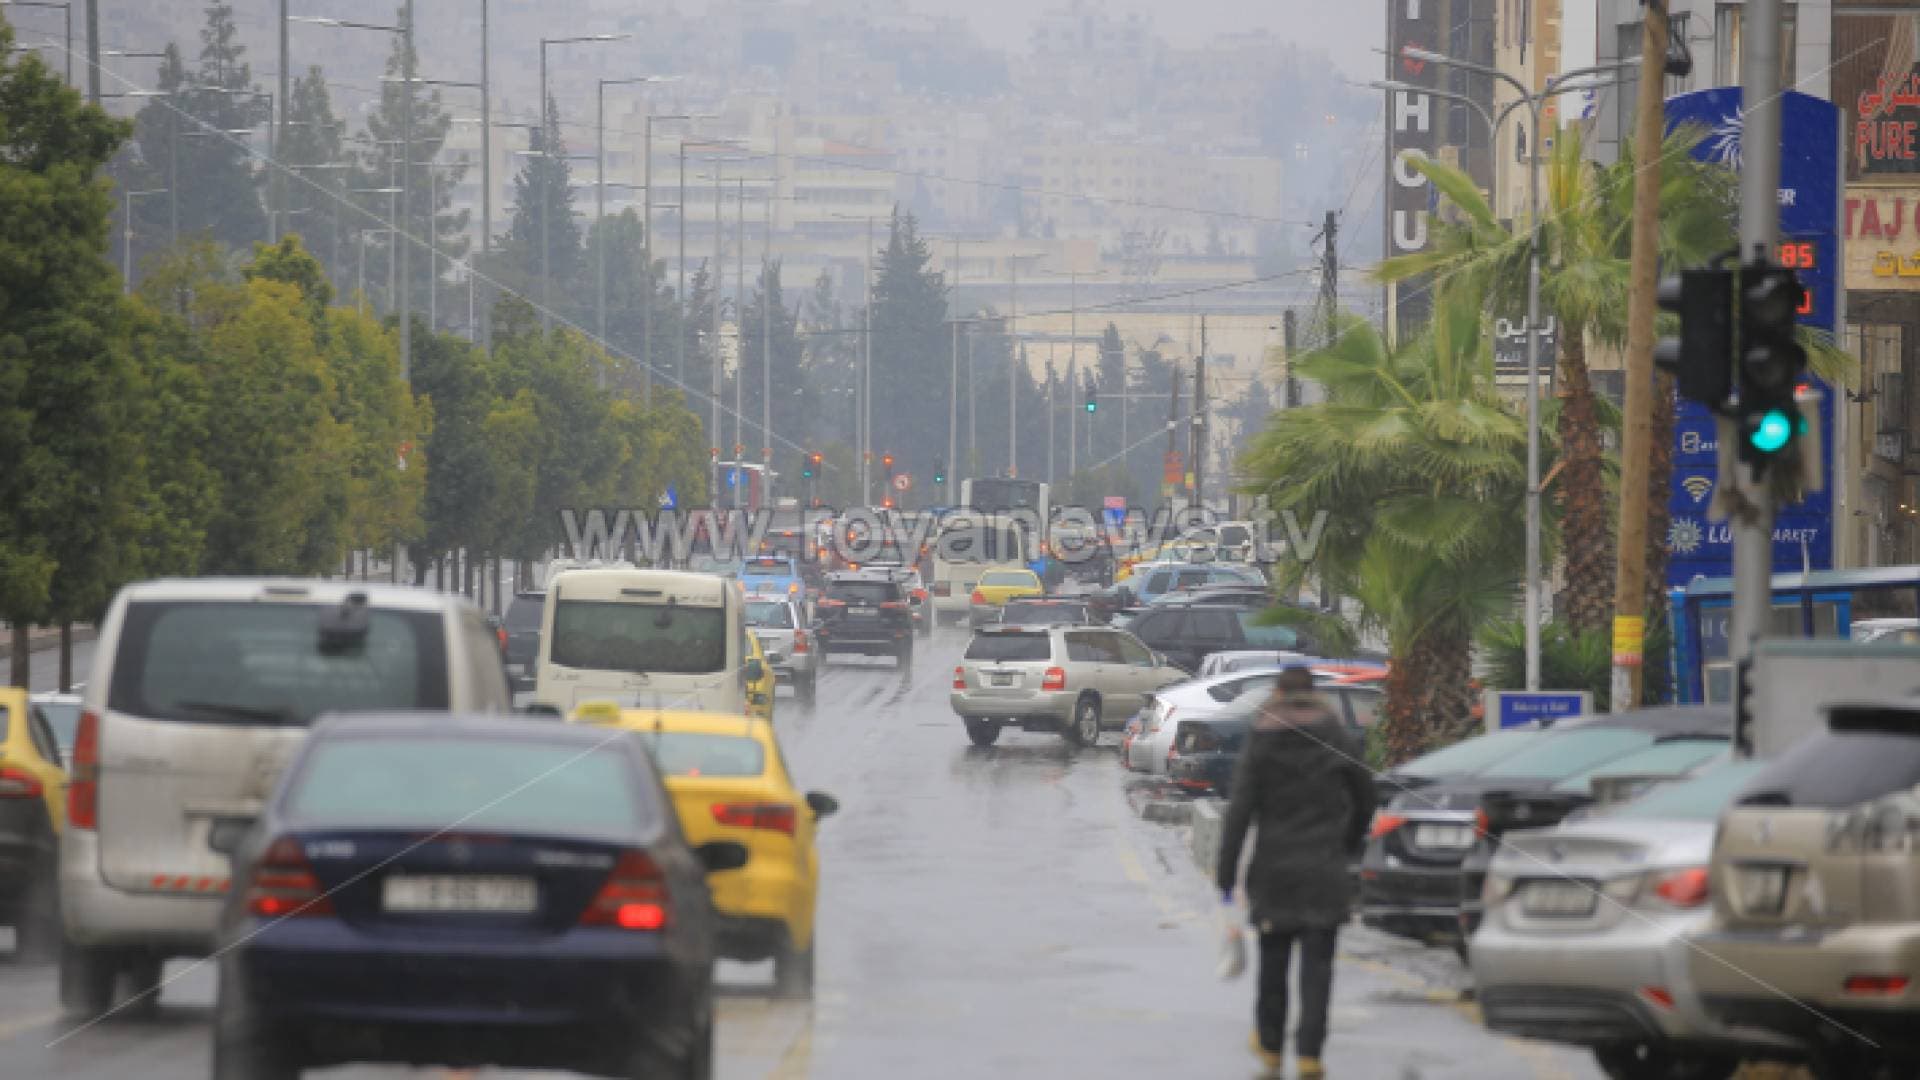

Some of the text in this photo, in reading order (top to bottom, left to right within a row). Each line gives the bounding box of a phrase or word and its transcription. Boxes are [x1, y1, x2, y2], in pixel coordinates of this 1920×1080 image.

[1856, 121, 1916, 159] PURE
[1844, 197, 1902, 237] TAJ
[1708, 525, 1818, 544] LU ARKET
